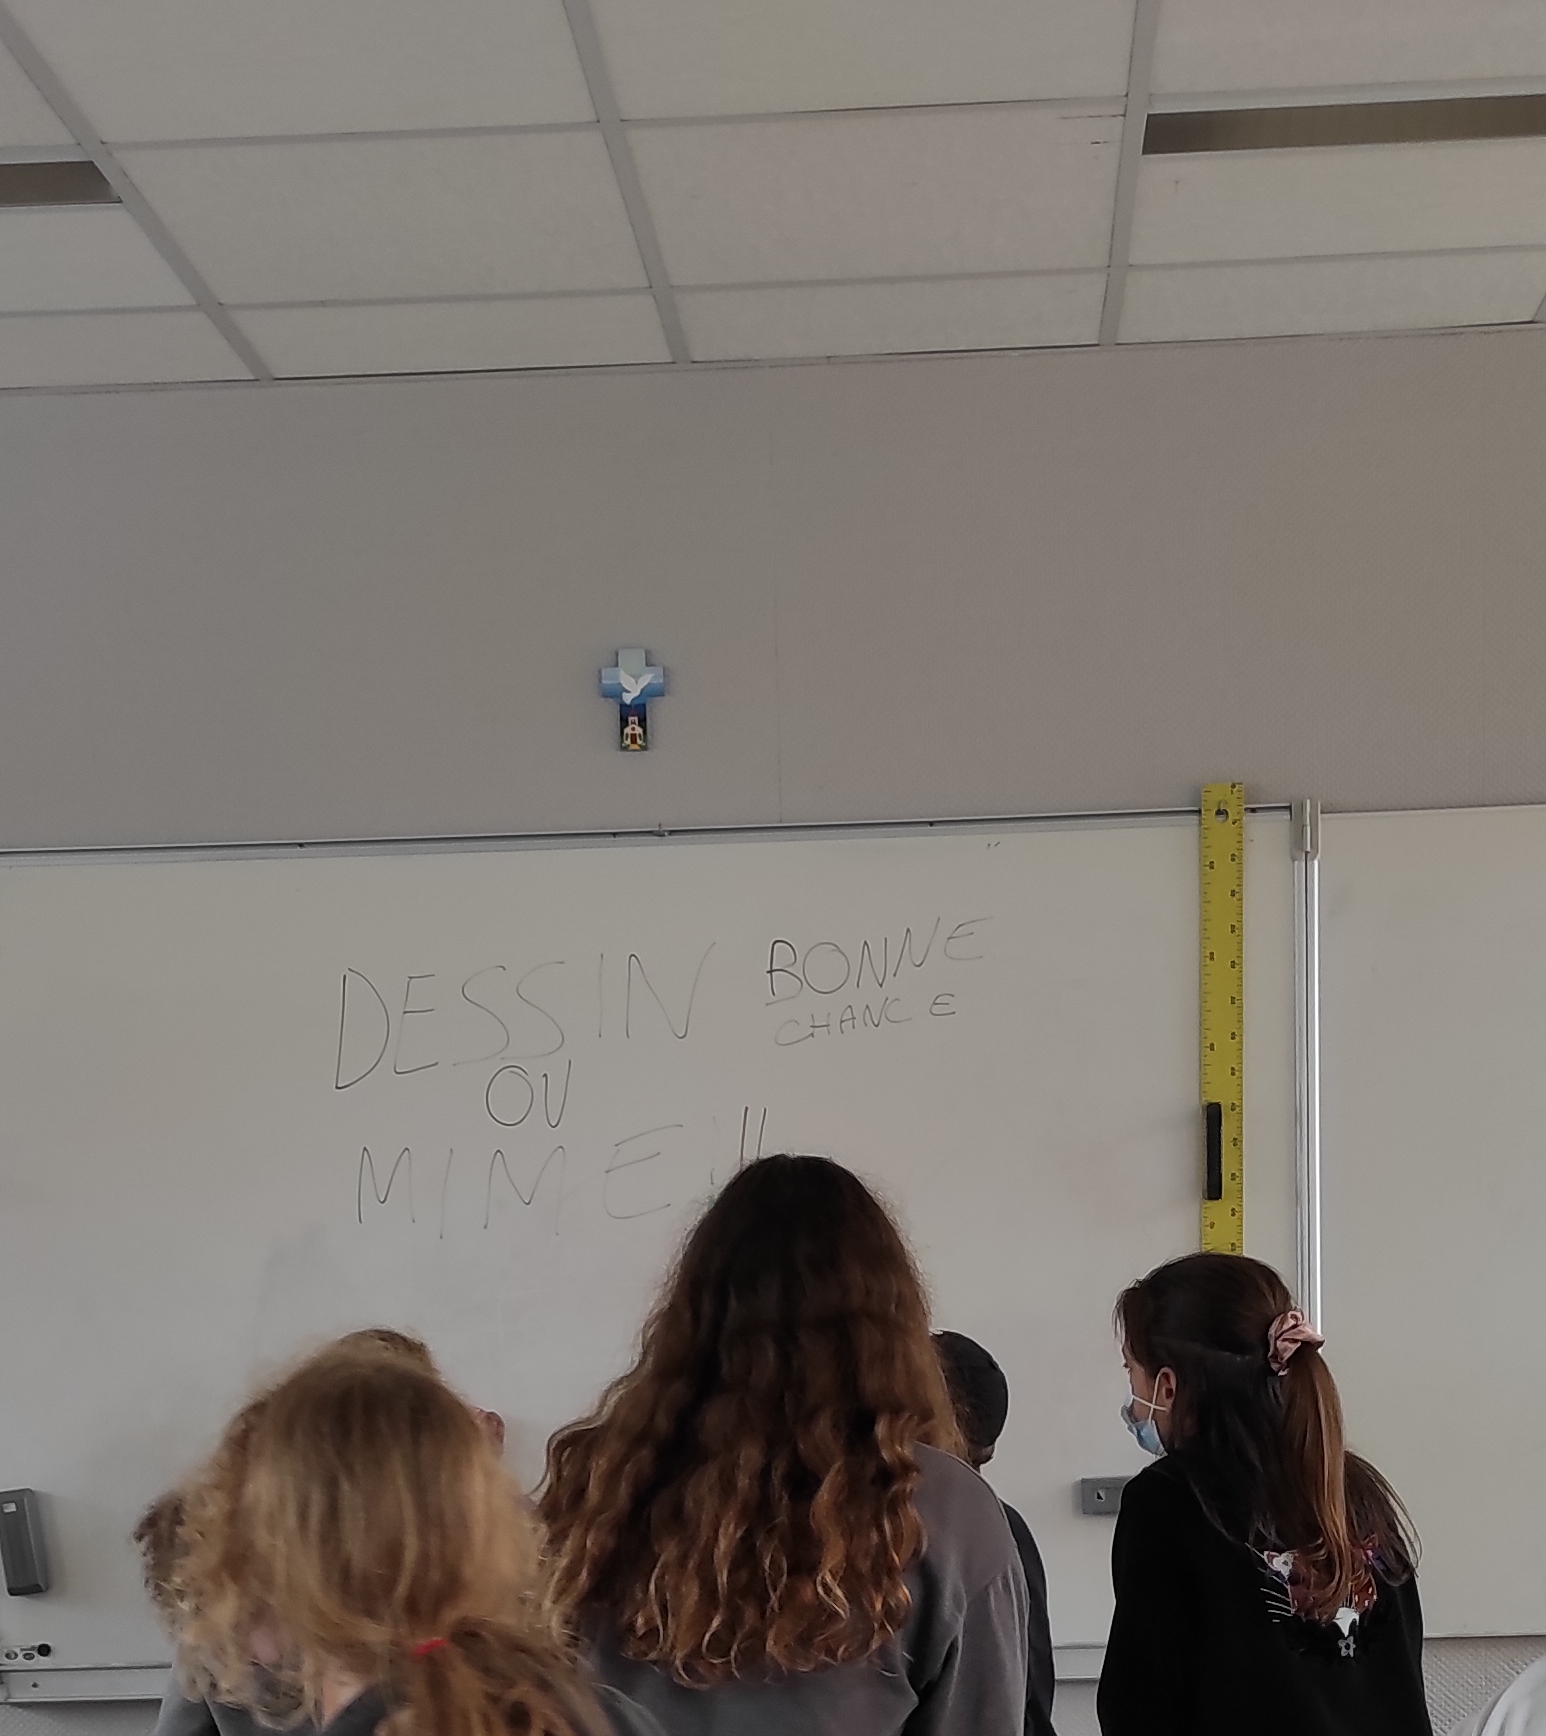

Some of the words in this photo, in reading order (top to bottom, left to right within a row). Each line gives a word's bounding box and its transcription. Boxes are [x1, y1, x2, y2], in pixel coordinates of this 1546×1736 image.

[334, 941, 718, 1091] DESSIN
[765, 916, 995, 1005] BONNE
[773, 992, 958, 1047] CHANCE
[484, 1059, 573, 1130] OU
[356, 1124, 685, 1240] MIME
